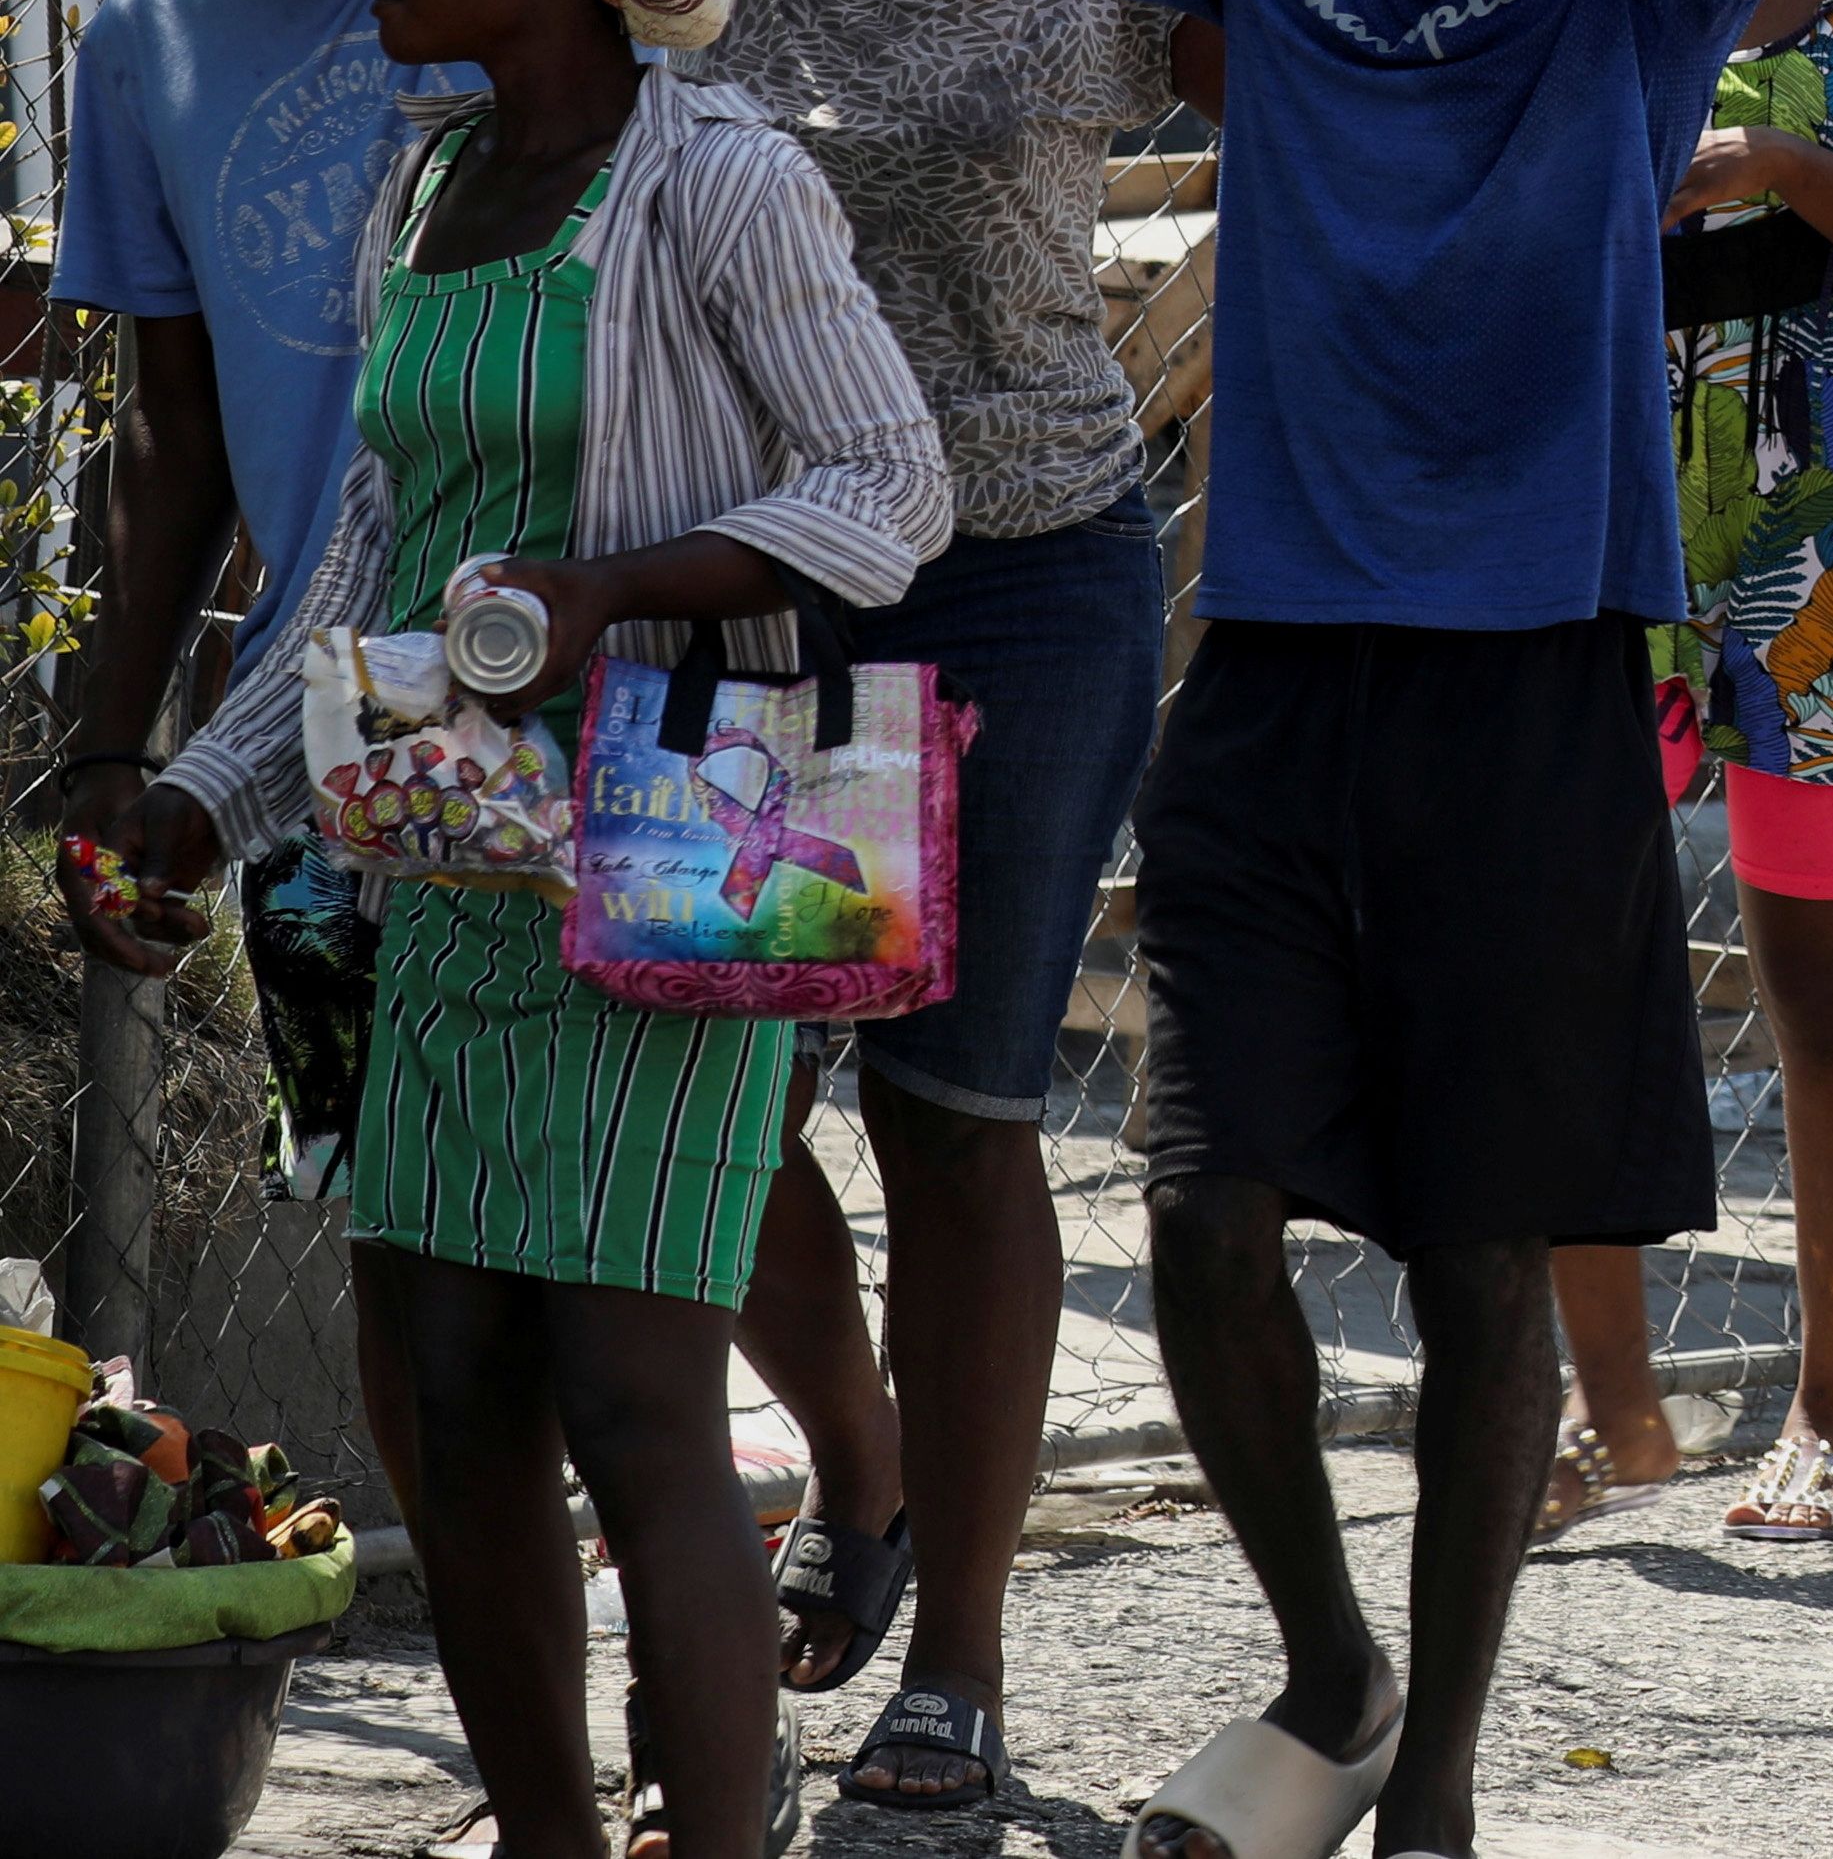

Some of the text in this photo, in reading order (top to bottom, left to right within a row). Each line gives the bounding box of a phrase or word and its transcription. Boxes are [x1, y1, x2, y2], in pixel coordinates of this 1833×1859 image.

[266, 57, 390, 144] MAISON
[592, 764, 718, 824] faith
[648, 918, 768, 940] Believe
[797, 882, 893, 925] Hope
